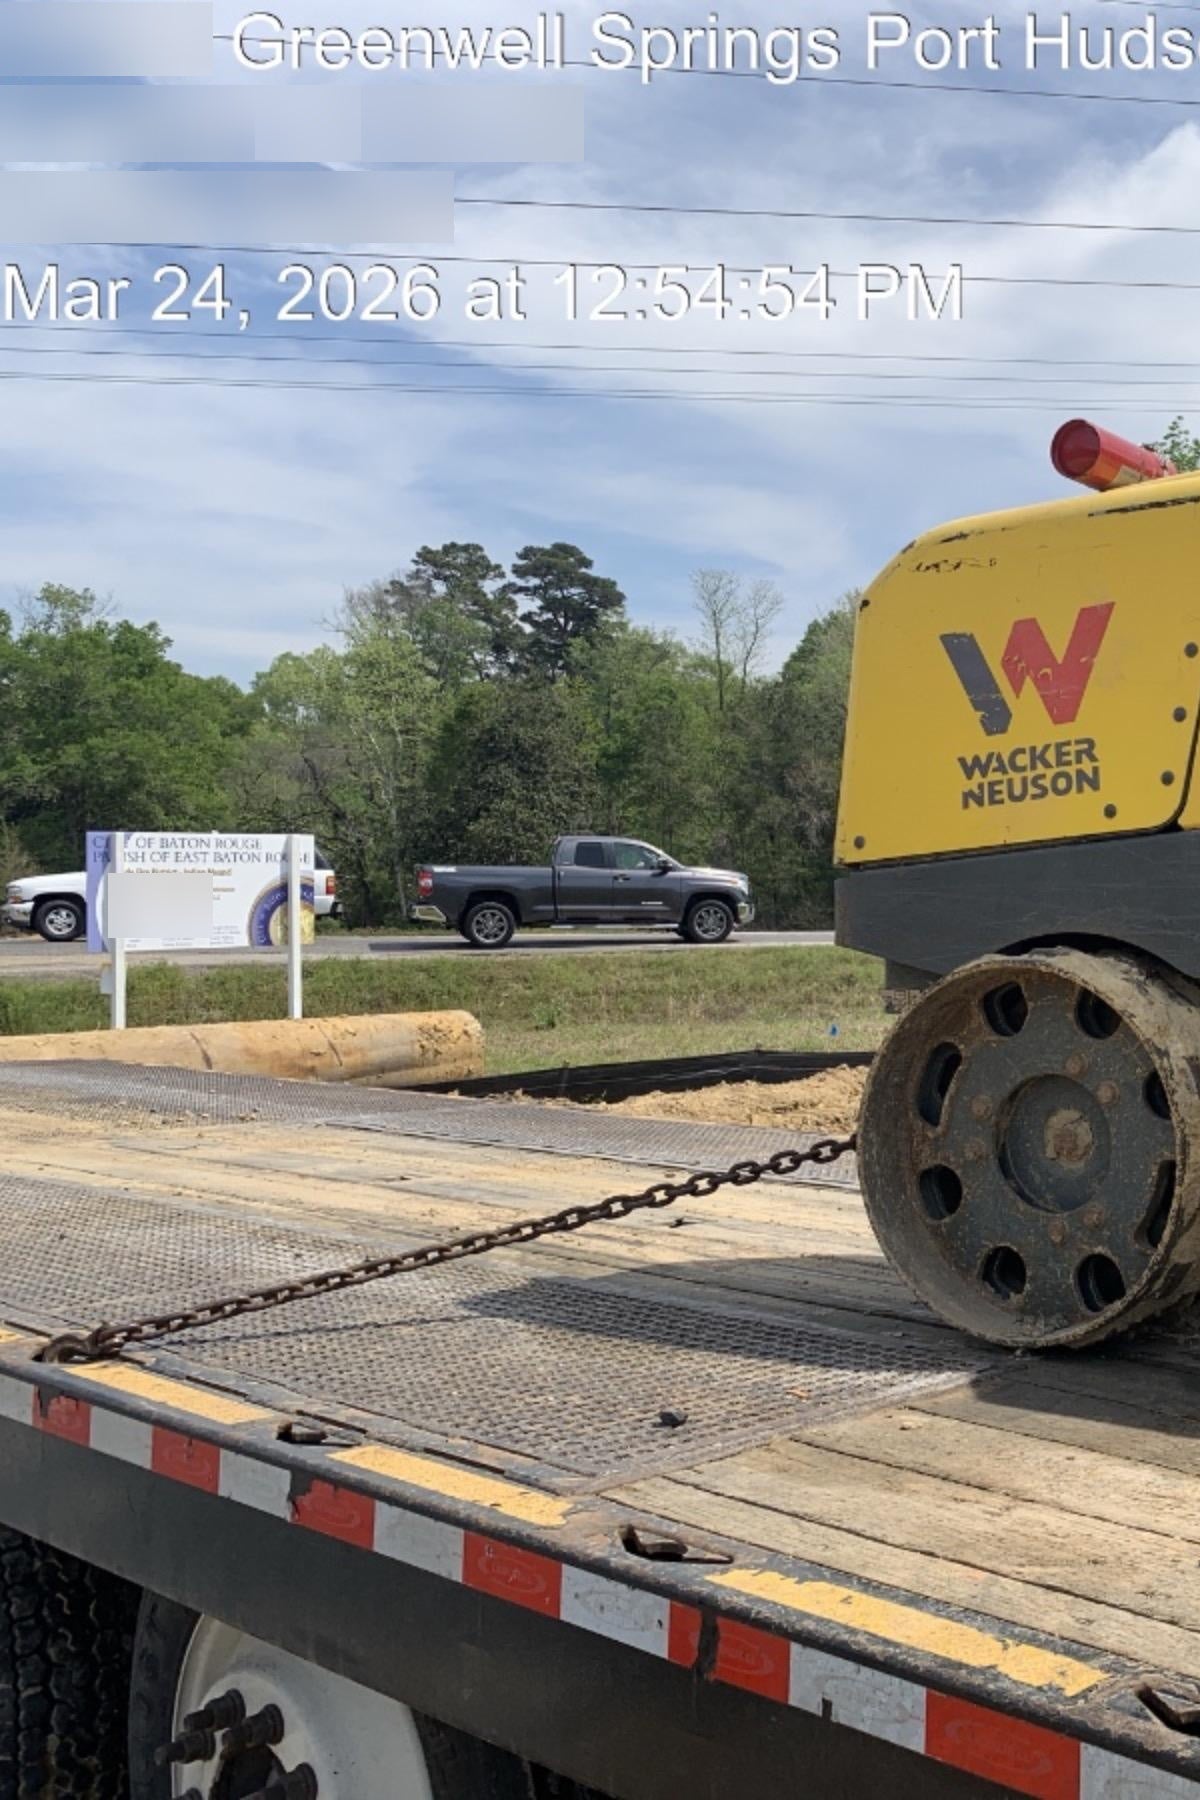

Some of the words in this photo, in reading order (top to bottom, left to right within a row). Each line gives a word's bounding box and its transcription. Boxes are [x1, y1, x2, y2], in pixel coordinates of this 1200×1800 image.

[957, 737, 1099, 780] WACKER
[961, 766, 1101, 810] NEUSON
[135, 837, 156, 849] OF
[159, 837, 211, 849] BATON
[215, 837, 262, 850] ROUGE
[149, 851, 171, 863] OF
[174, 851, 209, 863] EAST
[213, 851, 261, 864] BATON
